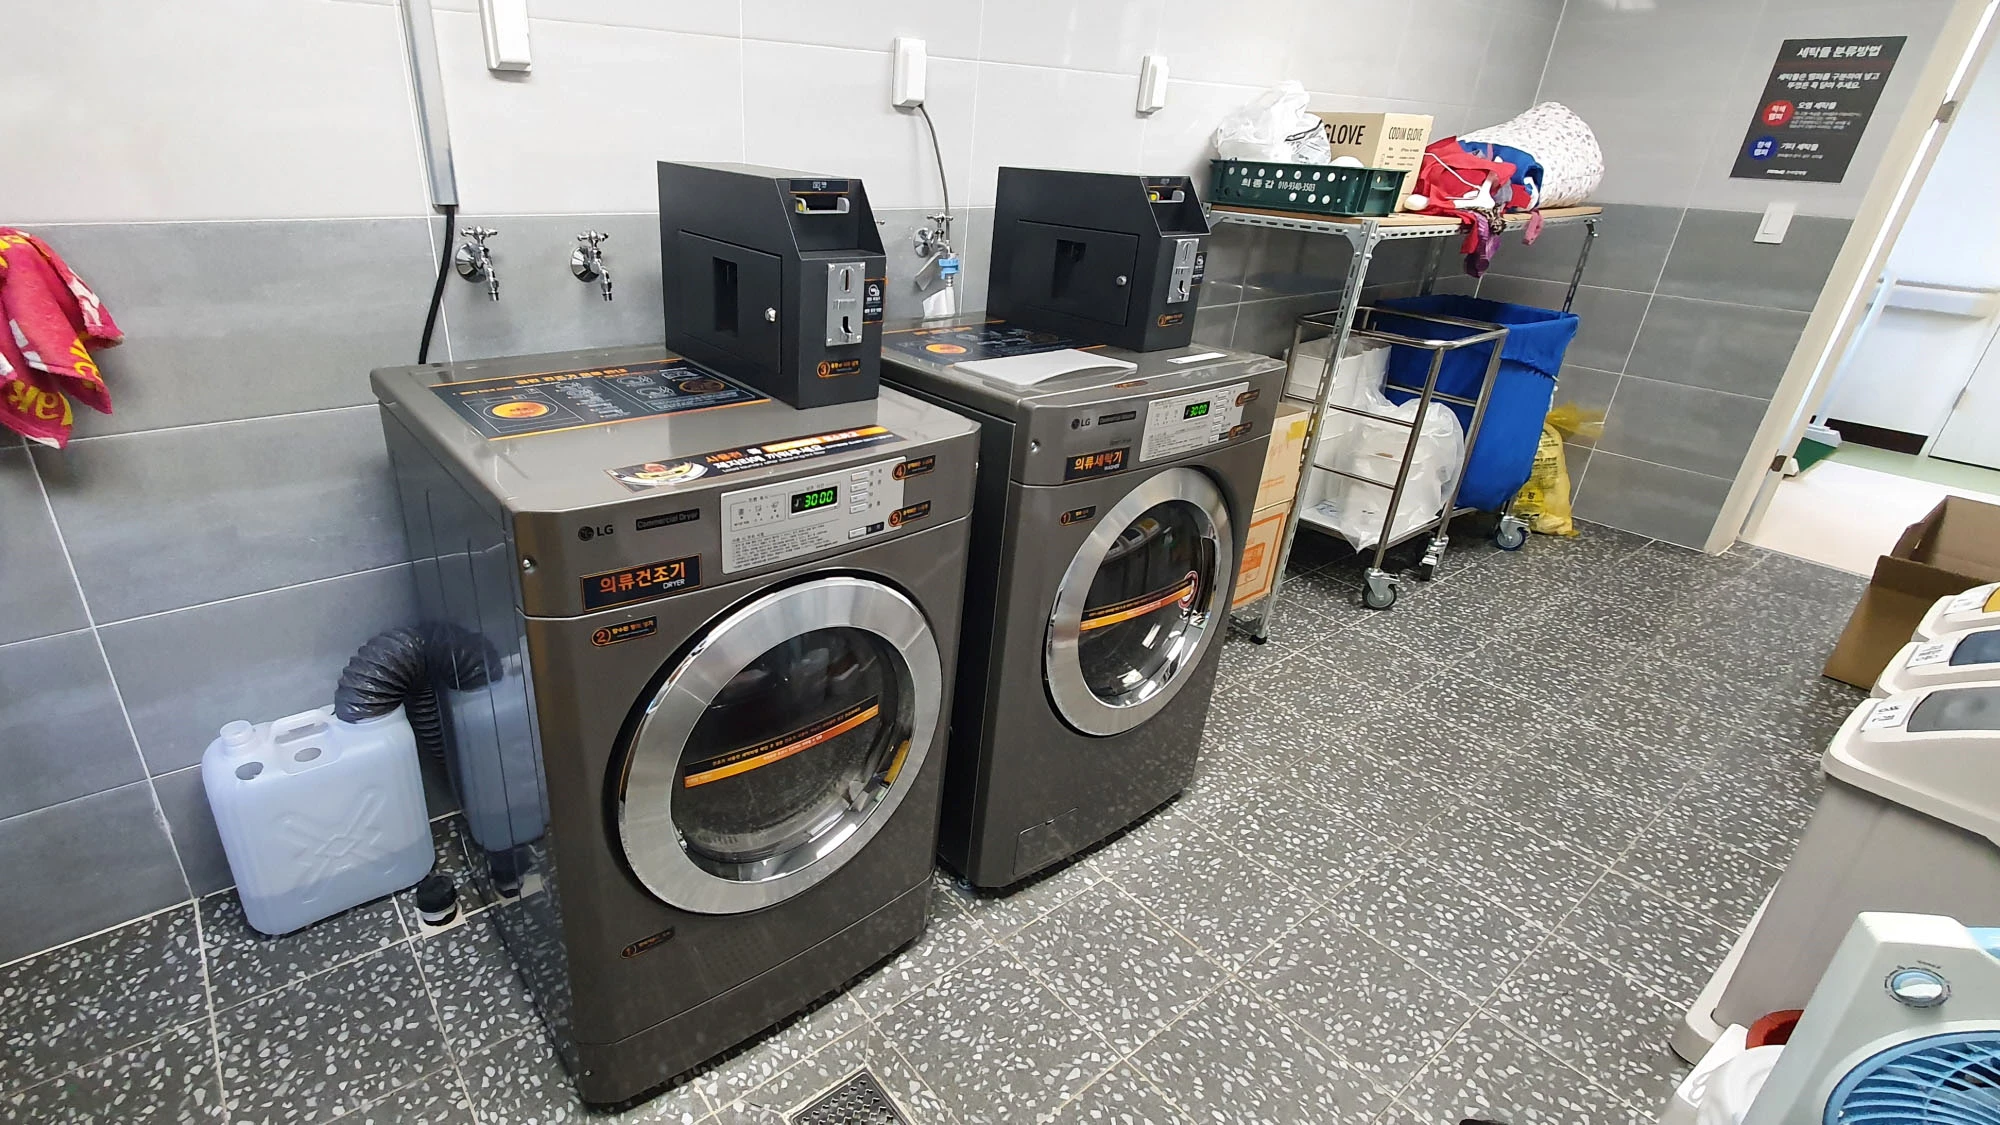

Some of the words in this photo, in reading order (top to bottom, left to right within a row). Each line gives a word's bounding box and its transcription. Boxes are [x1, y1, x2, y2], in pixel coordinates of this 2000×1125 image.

[1796, 46, 1831, 59] 세탁물
[1834, 44, 1882, 58] 분류방법
[1324, 123, 1366, 145] GLOVE
[1406, 127, 1424, 142] GLOVE
[713, 455, 766, 469] 제자리에
[1074, 450, 1122, 471] 의류세탁기
[596, 524, 614, 537] LG
[637, 514, 679, 529] Commercial
[678, 511, 699, 522] Dryer
[600, 561, 685, 593] 의류건조기
[663, 578, 685, 590] DRYER
[596, 631, 607, 643] 2
